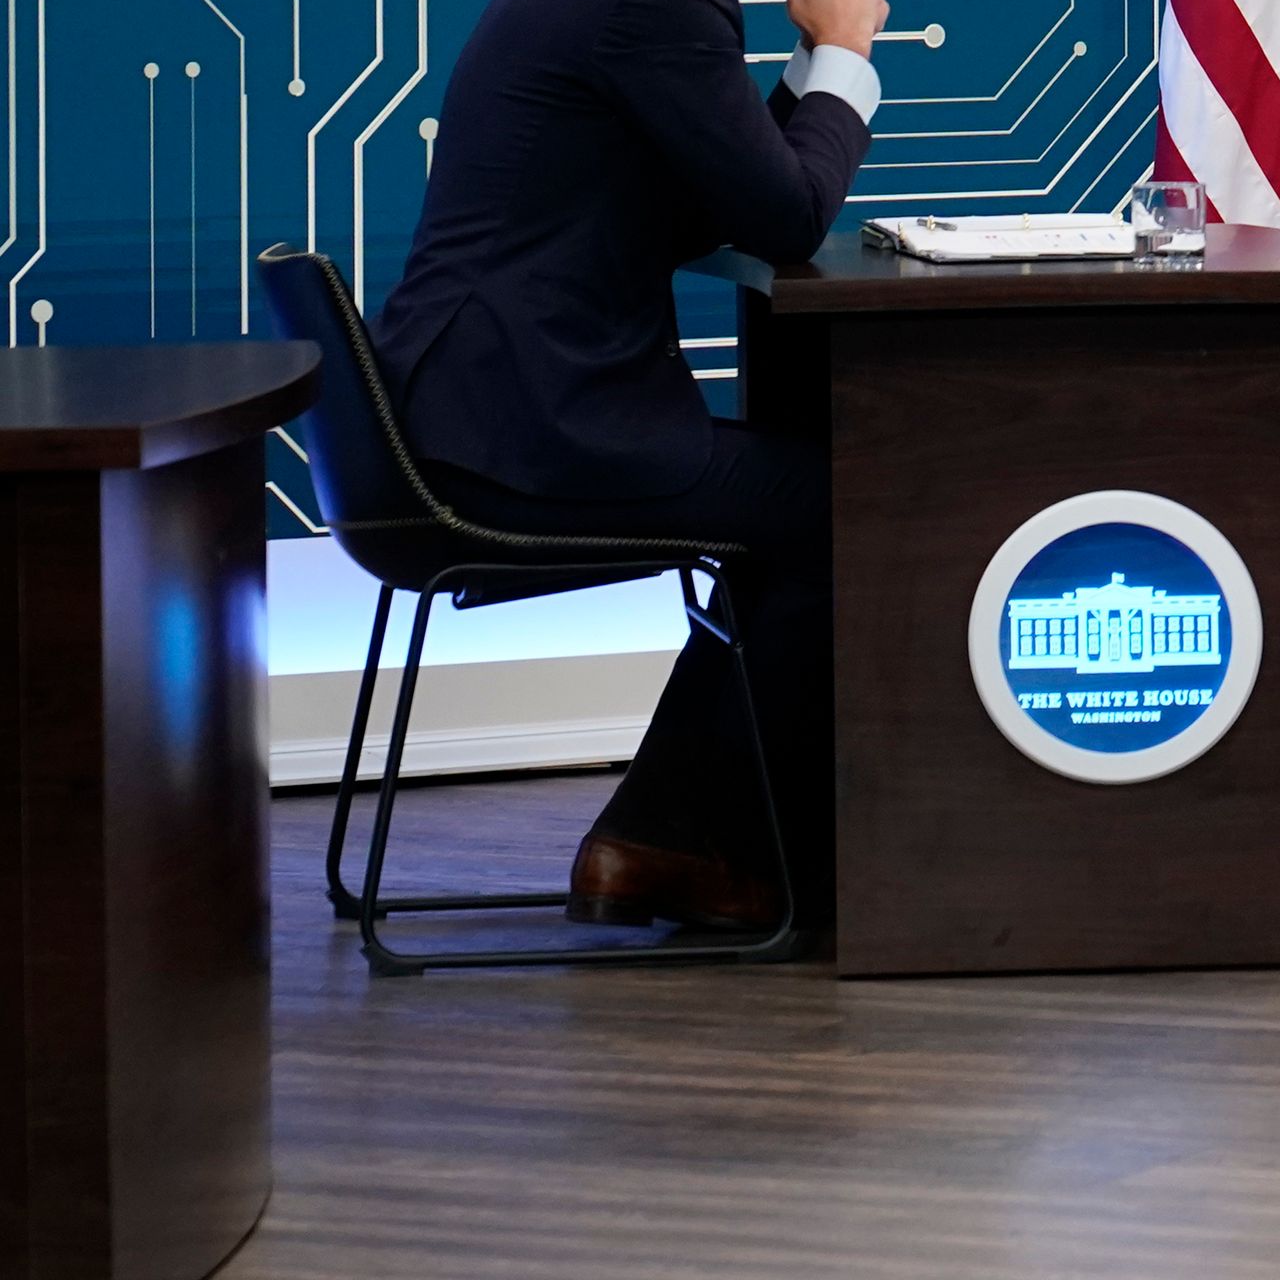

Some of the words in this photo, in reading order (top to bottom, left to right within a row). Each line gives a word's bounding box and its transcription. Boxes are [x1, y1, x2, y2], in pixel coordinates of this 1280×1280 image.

[1018, 693, 1062, 709] THE
[1066, 690, 1139, 708] WHITE
[1143, 688, 1214, 706] HOUSE
[1071, 710, 1161, 724] WASHINGTON
